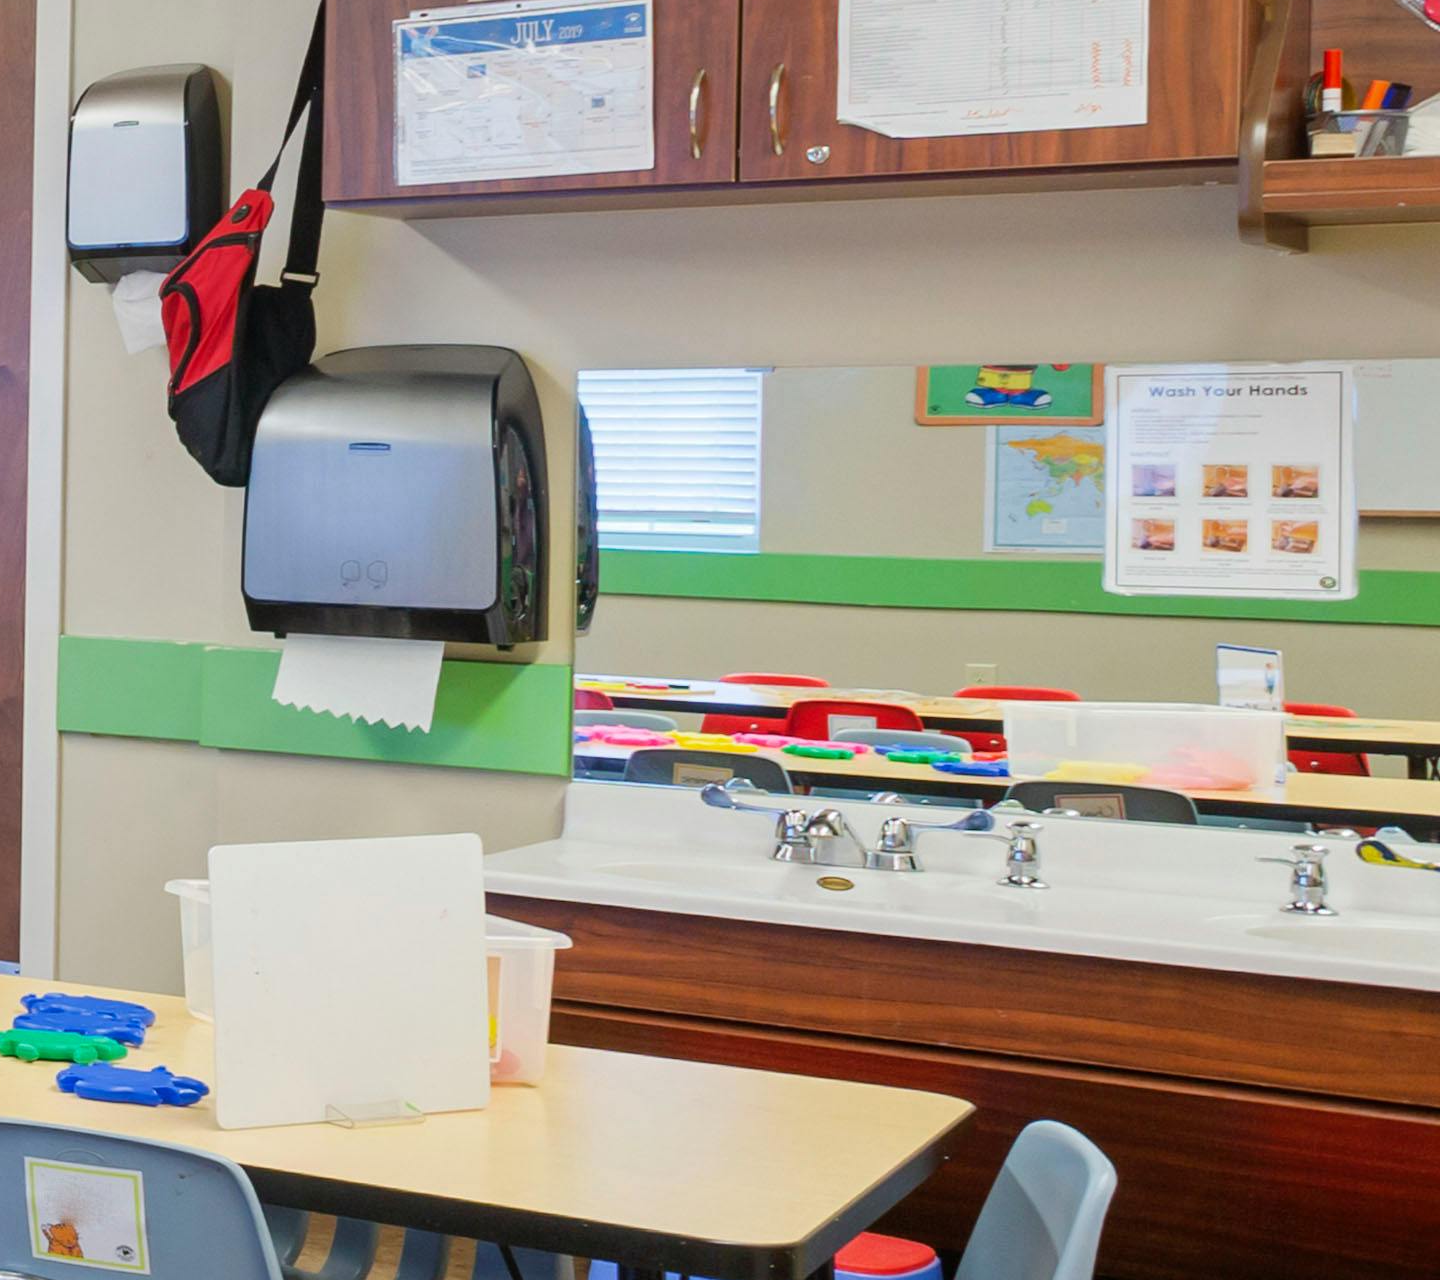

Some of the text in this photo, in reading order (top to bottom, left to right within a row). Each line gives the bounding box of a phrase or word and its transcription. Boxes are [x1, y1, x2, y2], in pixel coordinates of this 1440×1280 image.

[510, 19, 584, 45] JULY 2019
[1149, 384, 1309, 398] Wash Your Hands
